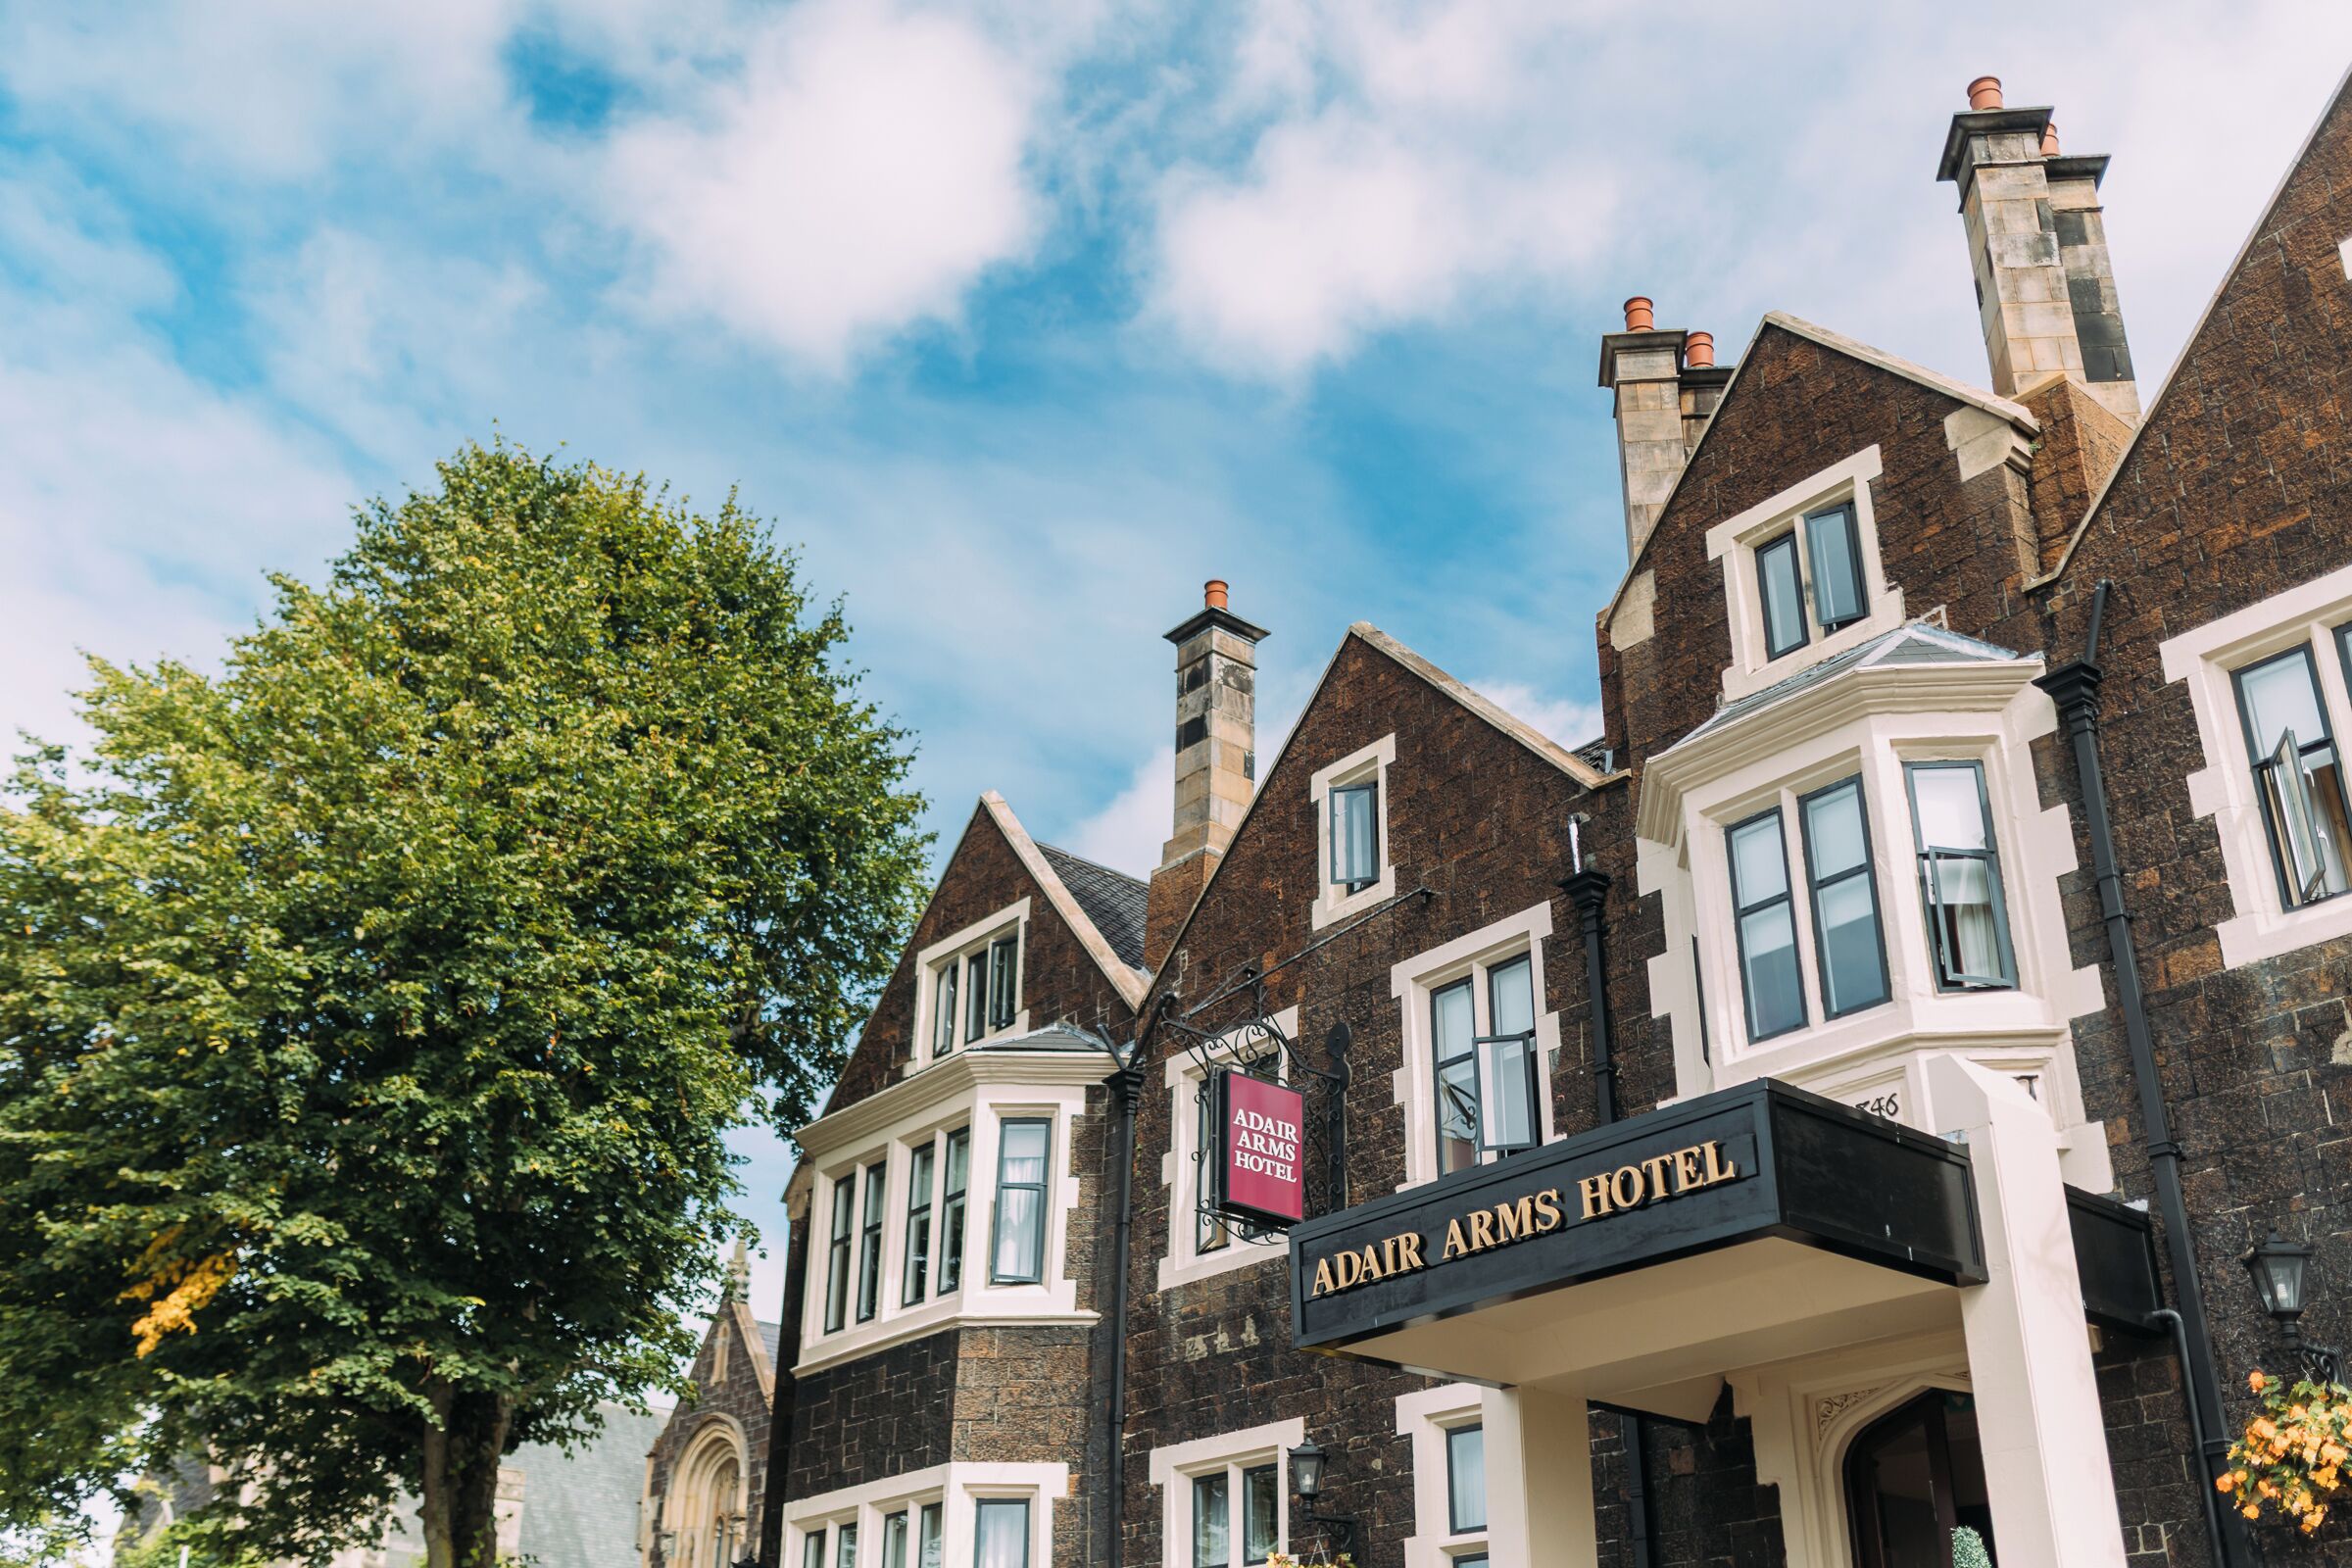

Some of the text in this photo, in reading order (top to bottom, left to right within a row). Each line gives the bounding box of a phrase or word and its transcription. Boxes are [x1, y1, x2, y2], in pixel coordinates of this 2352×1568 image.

[1234, 1109, 1298, 1144] ADAIR
[1238, 1131, 1296, 1162] ARMS
[1235, 1151, 1297, 1183] HOTEL
[1312, 1141, 1735, 1297] ADAIR ARMS HOTEL
